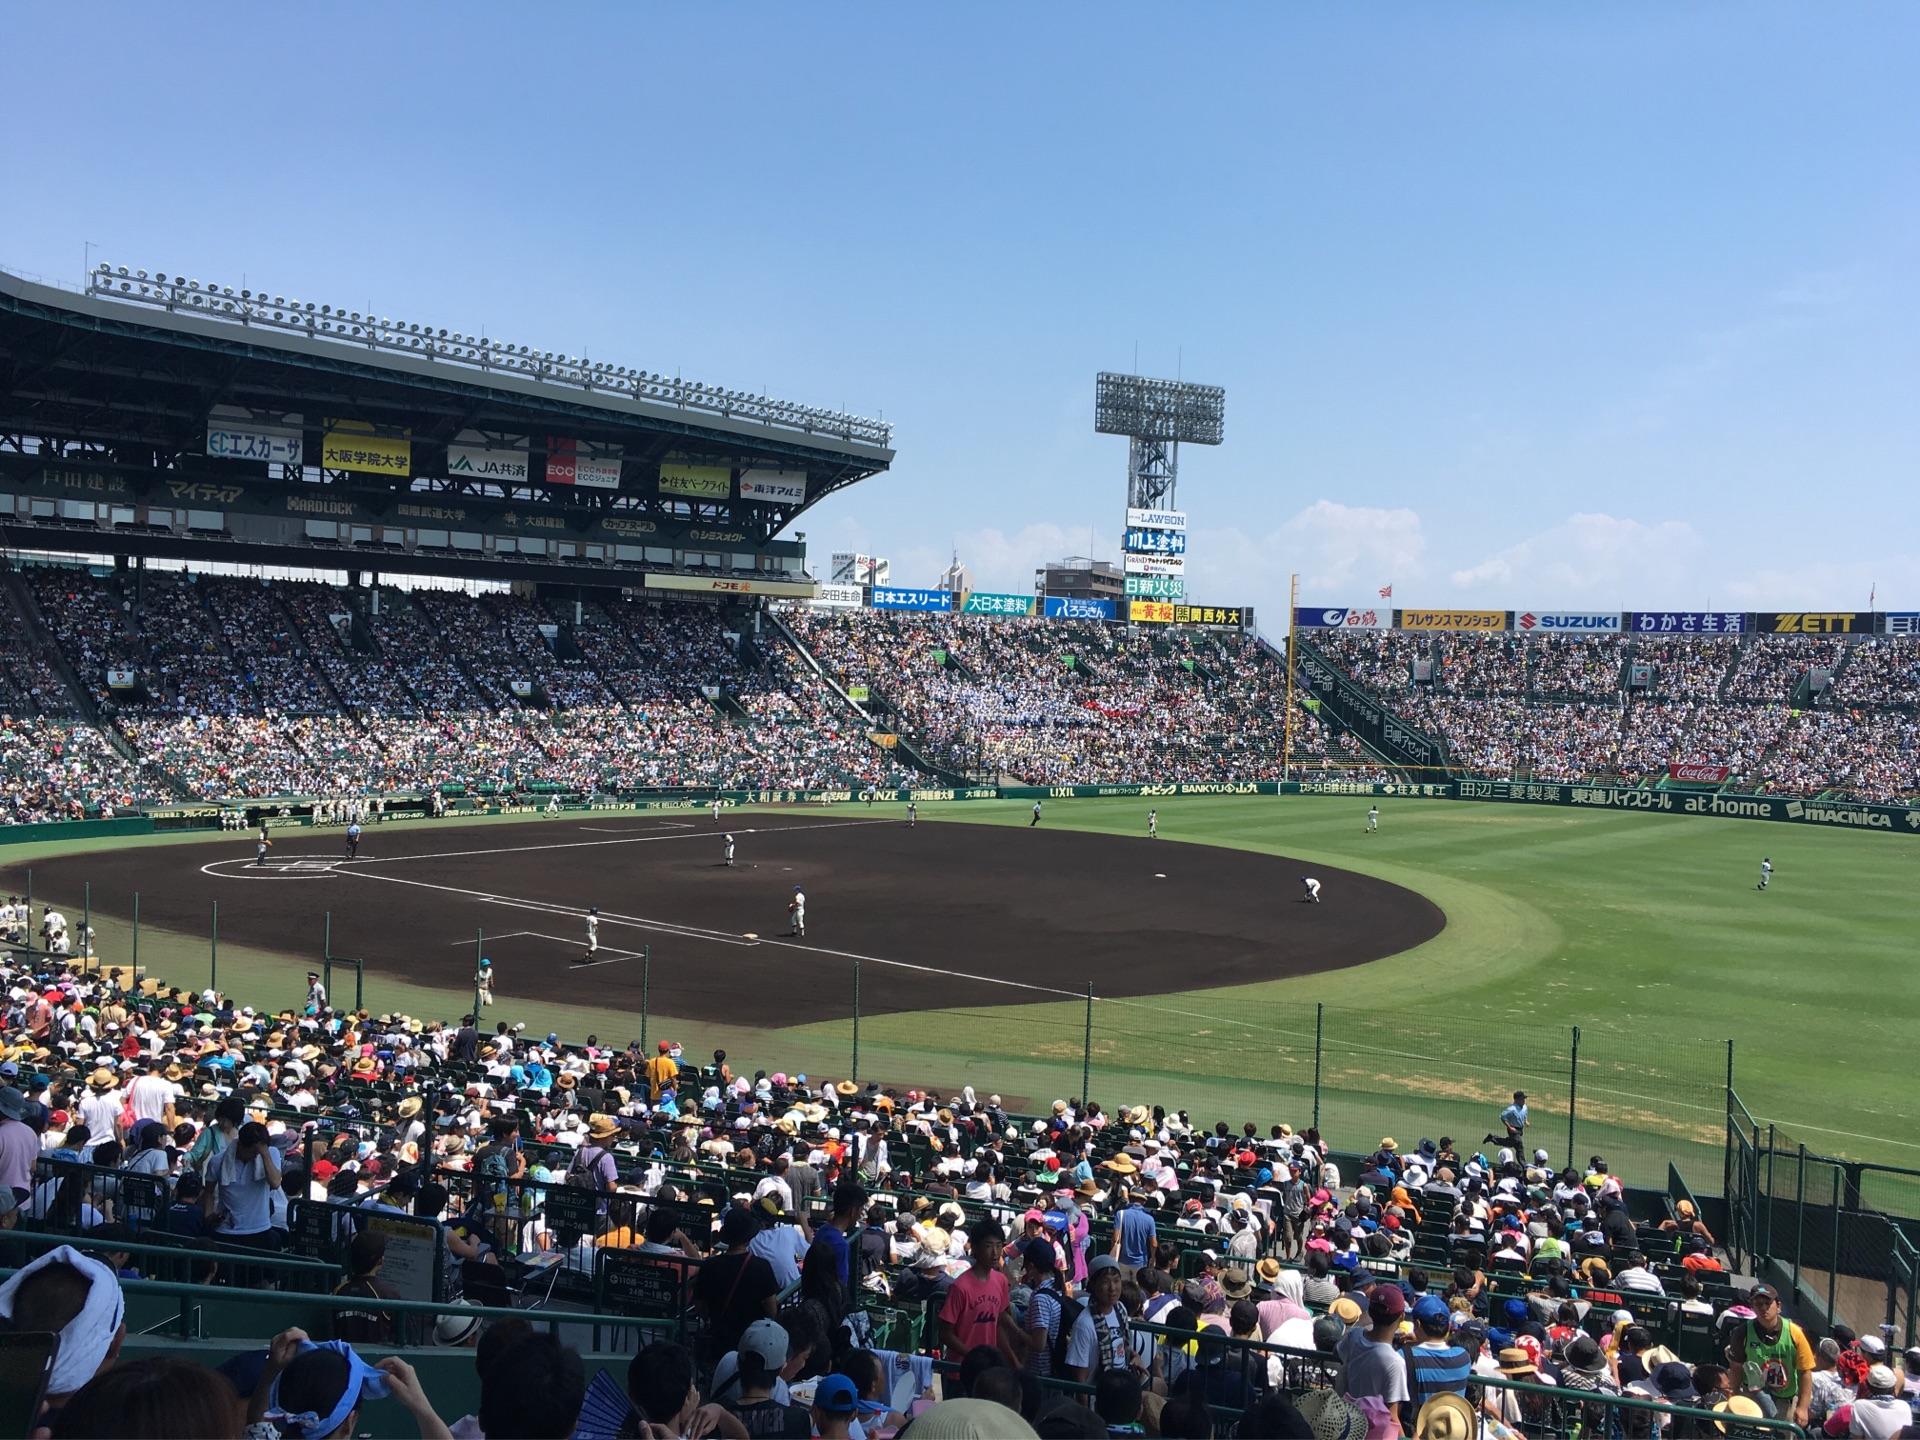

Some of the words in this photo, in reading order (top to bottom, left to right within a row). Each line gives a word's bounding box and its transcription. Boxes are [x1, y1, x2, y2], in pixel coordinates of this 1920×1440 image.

[230, 434, 300, 460] エスカーサ
[325, 448, 408, 469] 大阪学院大学
[477, 461, 527, 477] JA共済
[547, 464, 575, 476] ECC
[669, 476, 729, 492] 住友ベークライト
[754, 484, 804, 497] 東洋アルミ
[1141, 513, 1185, 526] LAWSON
[1128, 532, 1184, 552] 川上塗料
[712, 581, 751, 592] ドコモ光
[1126, 578, 1182, 596] 日新火災
[821, 589, 861, 602] 安田生命
[874, 591, 951, 607] 日本エスリード
[969, 595, 1028, 613] 大日本塗料
[1069, 605, 1106, 619] ろうきん
[1142, 603, 1173, 621] 黄桜
[1191, 607, 1240, 624] 関西外大
[1347, 610, 1378, 627] 白鶴
[1407, 613, 1500, 627] プレサンスマンション
[1541, 615, 1618, 628] SUZUKI
[1639, 613, 1742, 633] わかさ生活
[1775, 613, 1856, 633] ZETT
[1296, 654, 1334, 692] 大同生命
[1384, 724, 1430, 762] 日興アセット
[1050, 786, 1075, 798] LIXIL
[1140, 784, 1177, 796] オービック
[1182, 784, 1224, 793] SANKYU
[1235, 782, 1258, 793] 山九
[1397, 784, 1446, 796] 住友電工
[1460, 782, 1560, 801] 田辺三菱製薬
[745, 791, 797, 803] 大和証券
[1571, 789, 1672, 809] 東進ハイスクール
[1684, 795, 1706, 812] at
[1708, 794, 1771, 817] home
